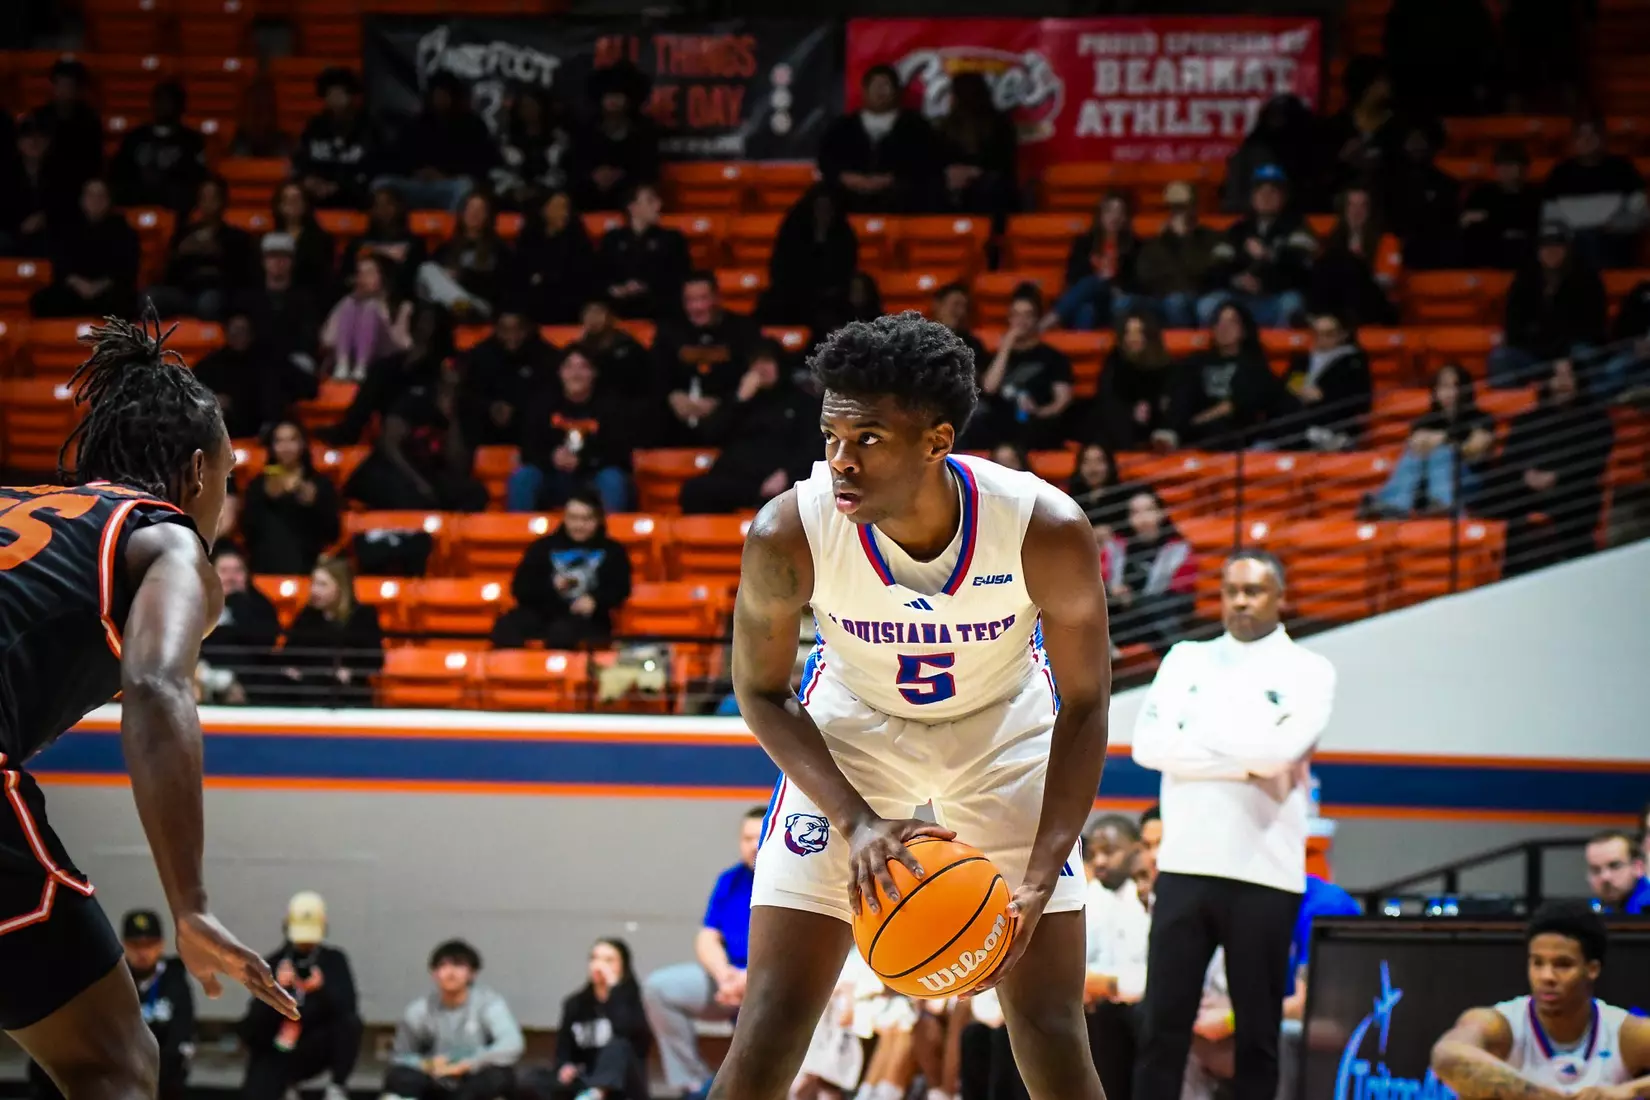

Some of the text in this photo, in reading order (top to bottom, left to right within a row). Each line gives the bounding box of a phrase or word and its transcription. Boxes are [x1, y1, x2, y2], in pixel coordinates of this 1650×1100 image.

[1095, 58, 1296, 94] BEARKAT
[686, 84, 746, 128] DAY
[896, 652, 957, 705] 5
[917, 913, 1007, 991] Wilson
